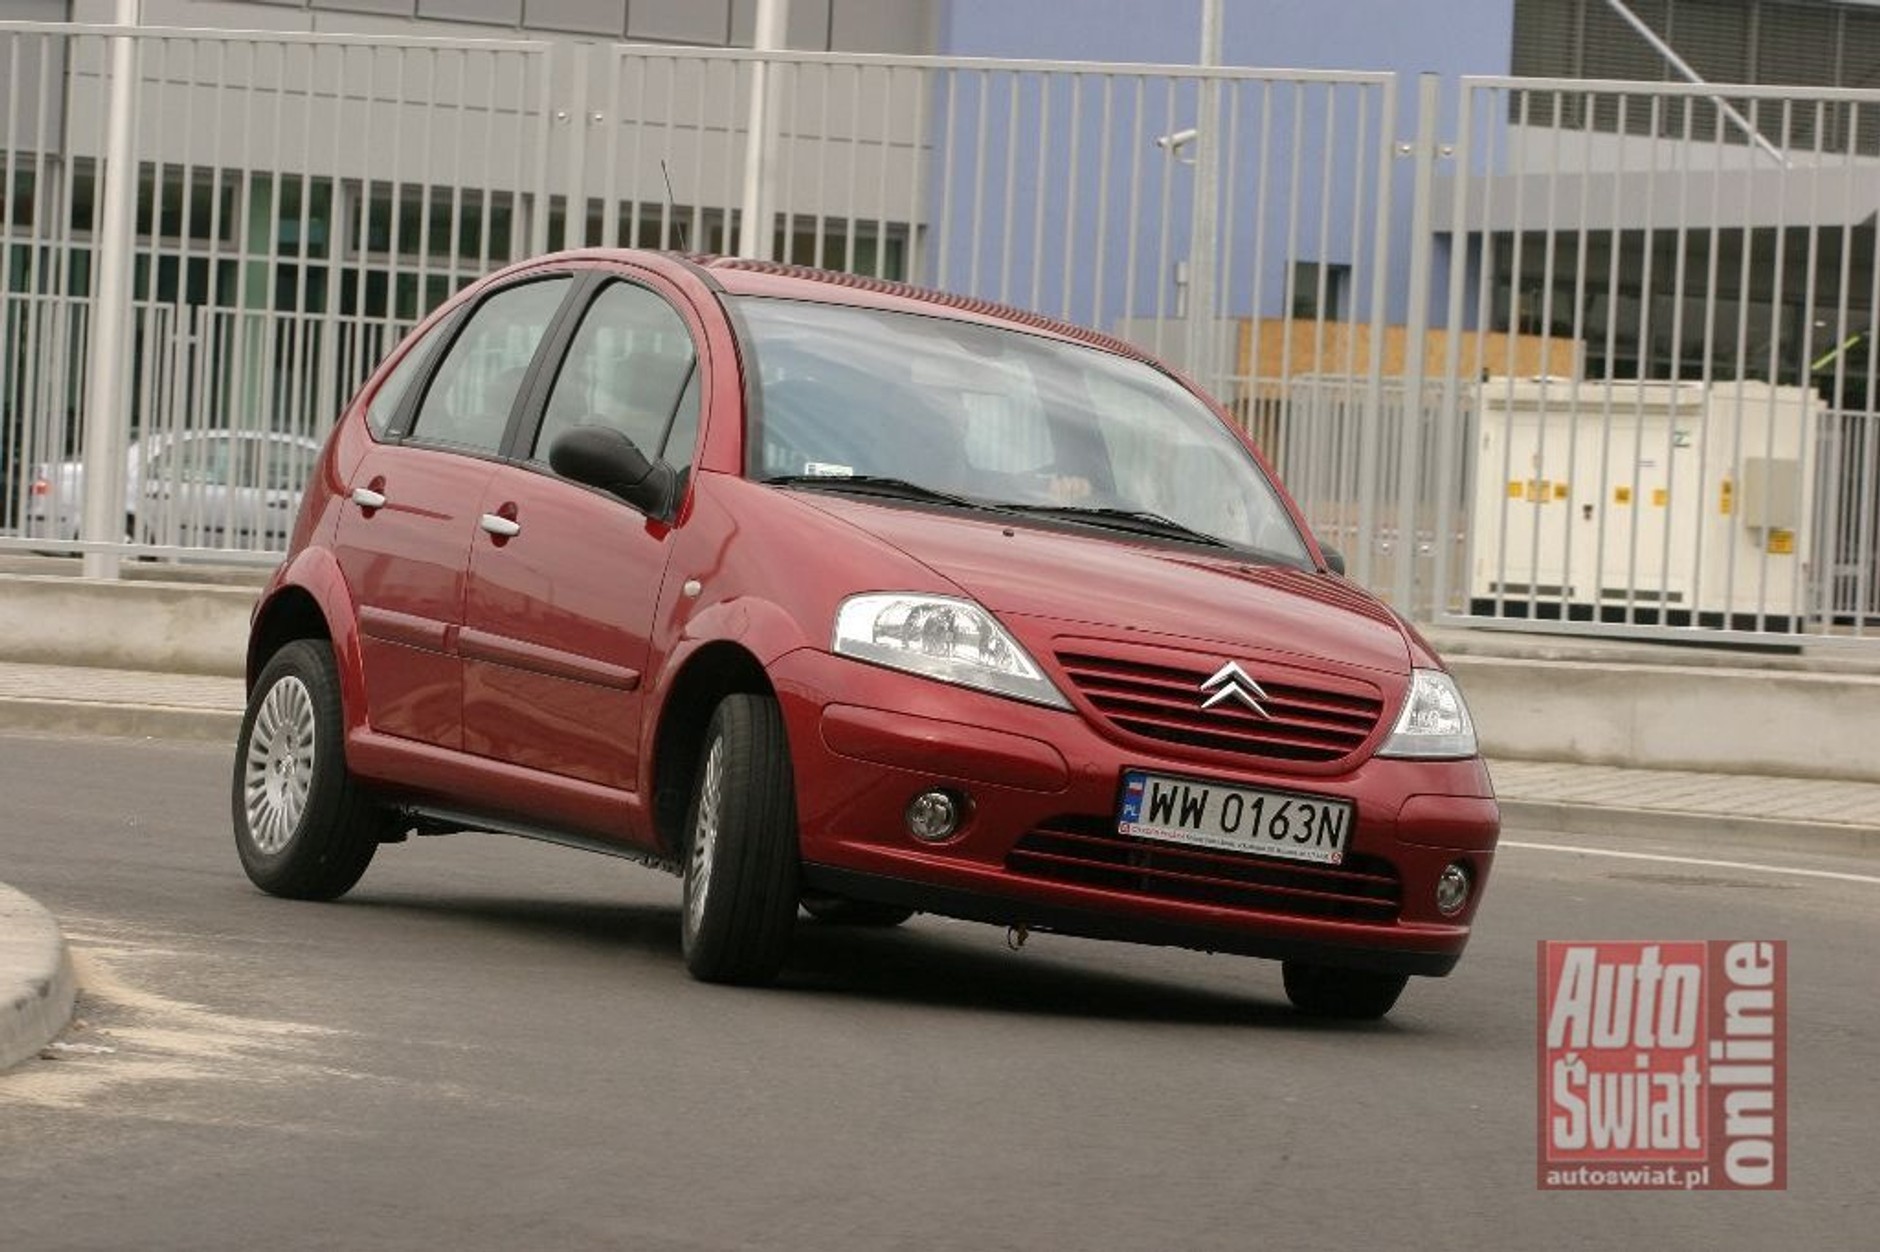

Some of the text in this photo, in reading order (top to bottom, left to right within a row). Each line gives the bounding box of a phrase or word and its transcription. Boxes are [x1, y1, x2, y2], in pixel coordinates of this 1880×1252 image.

[1123, 803, 1139, 817] PL
[1149, 782, 1210, 829] WW
[1220, 793, 1344, 848] 0163N
